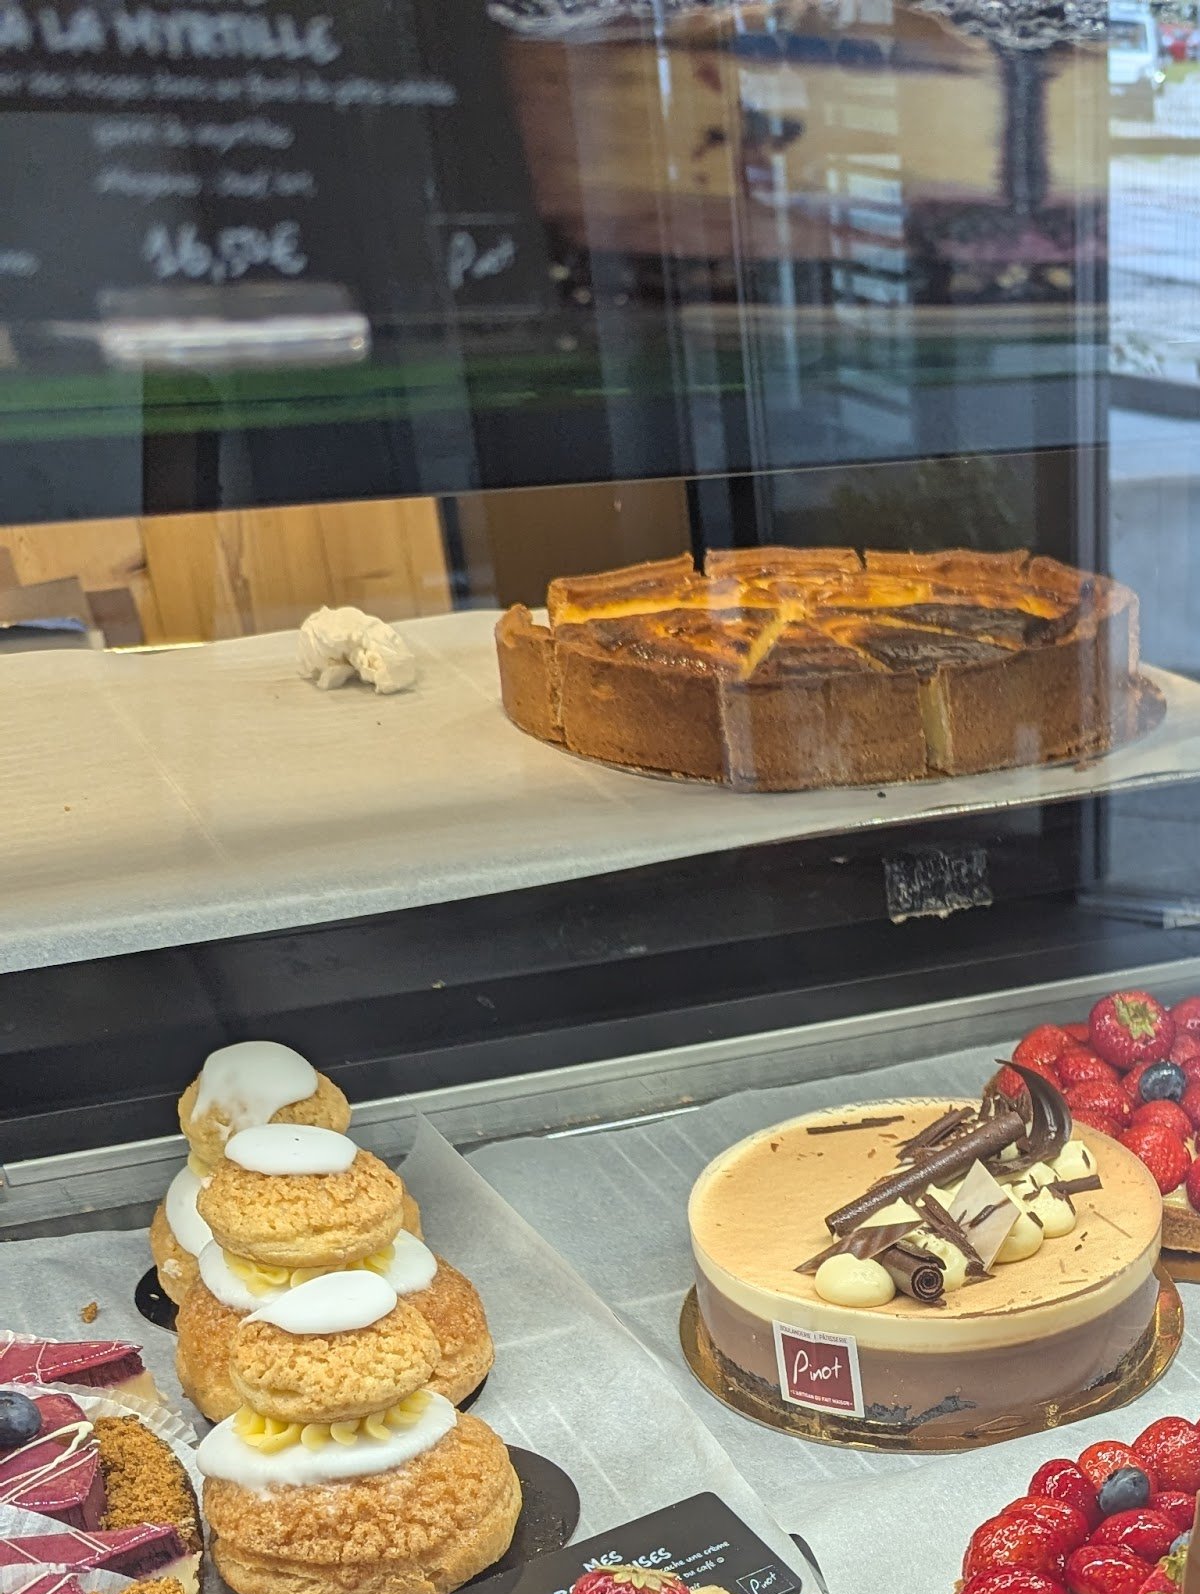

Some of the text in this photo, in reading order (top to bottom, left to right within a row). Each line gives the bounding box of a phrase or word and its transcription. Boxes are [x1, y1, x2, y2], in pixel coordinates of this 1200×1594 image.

[793, 1350, 842, 1385] Pinot
[582, 1550, 624, 1573] MES
[685, 1551, 704, 1563] une
[703, 1540, 731, 1556] crème
[696, 1559, 717, 1573] café
